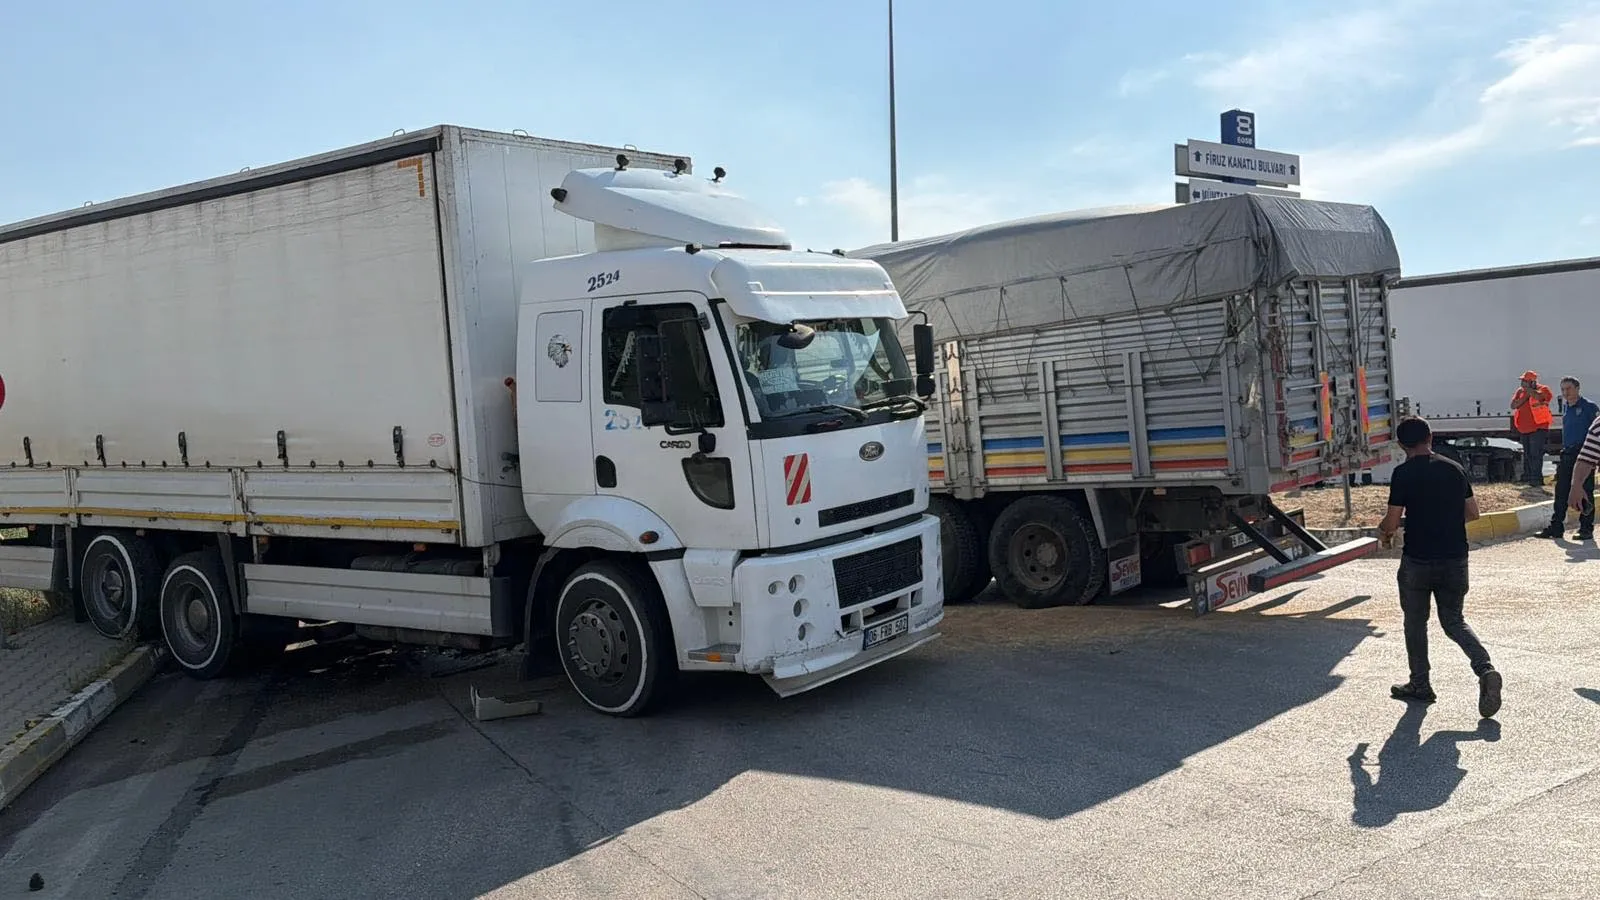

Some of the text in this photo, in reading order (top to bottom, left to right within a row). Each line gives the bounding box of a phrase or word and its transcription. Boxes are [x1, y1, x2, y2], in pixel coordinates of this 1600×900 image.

[1205, 151, 1286, 176] FİRUZ KANATLI BULVARI
[587, 269, 620, 292] 2524
[659, 440, 692, 449] CARGO
